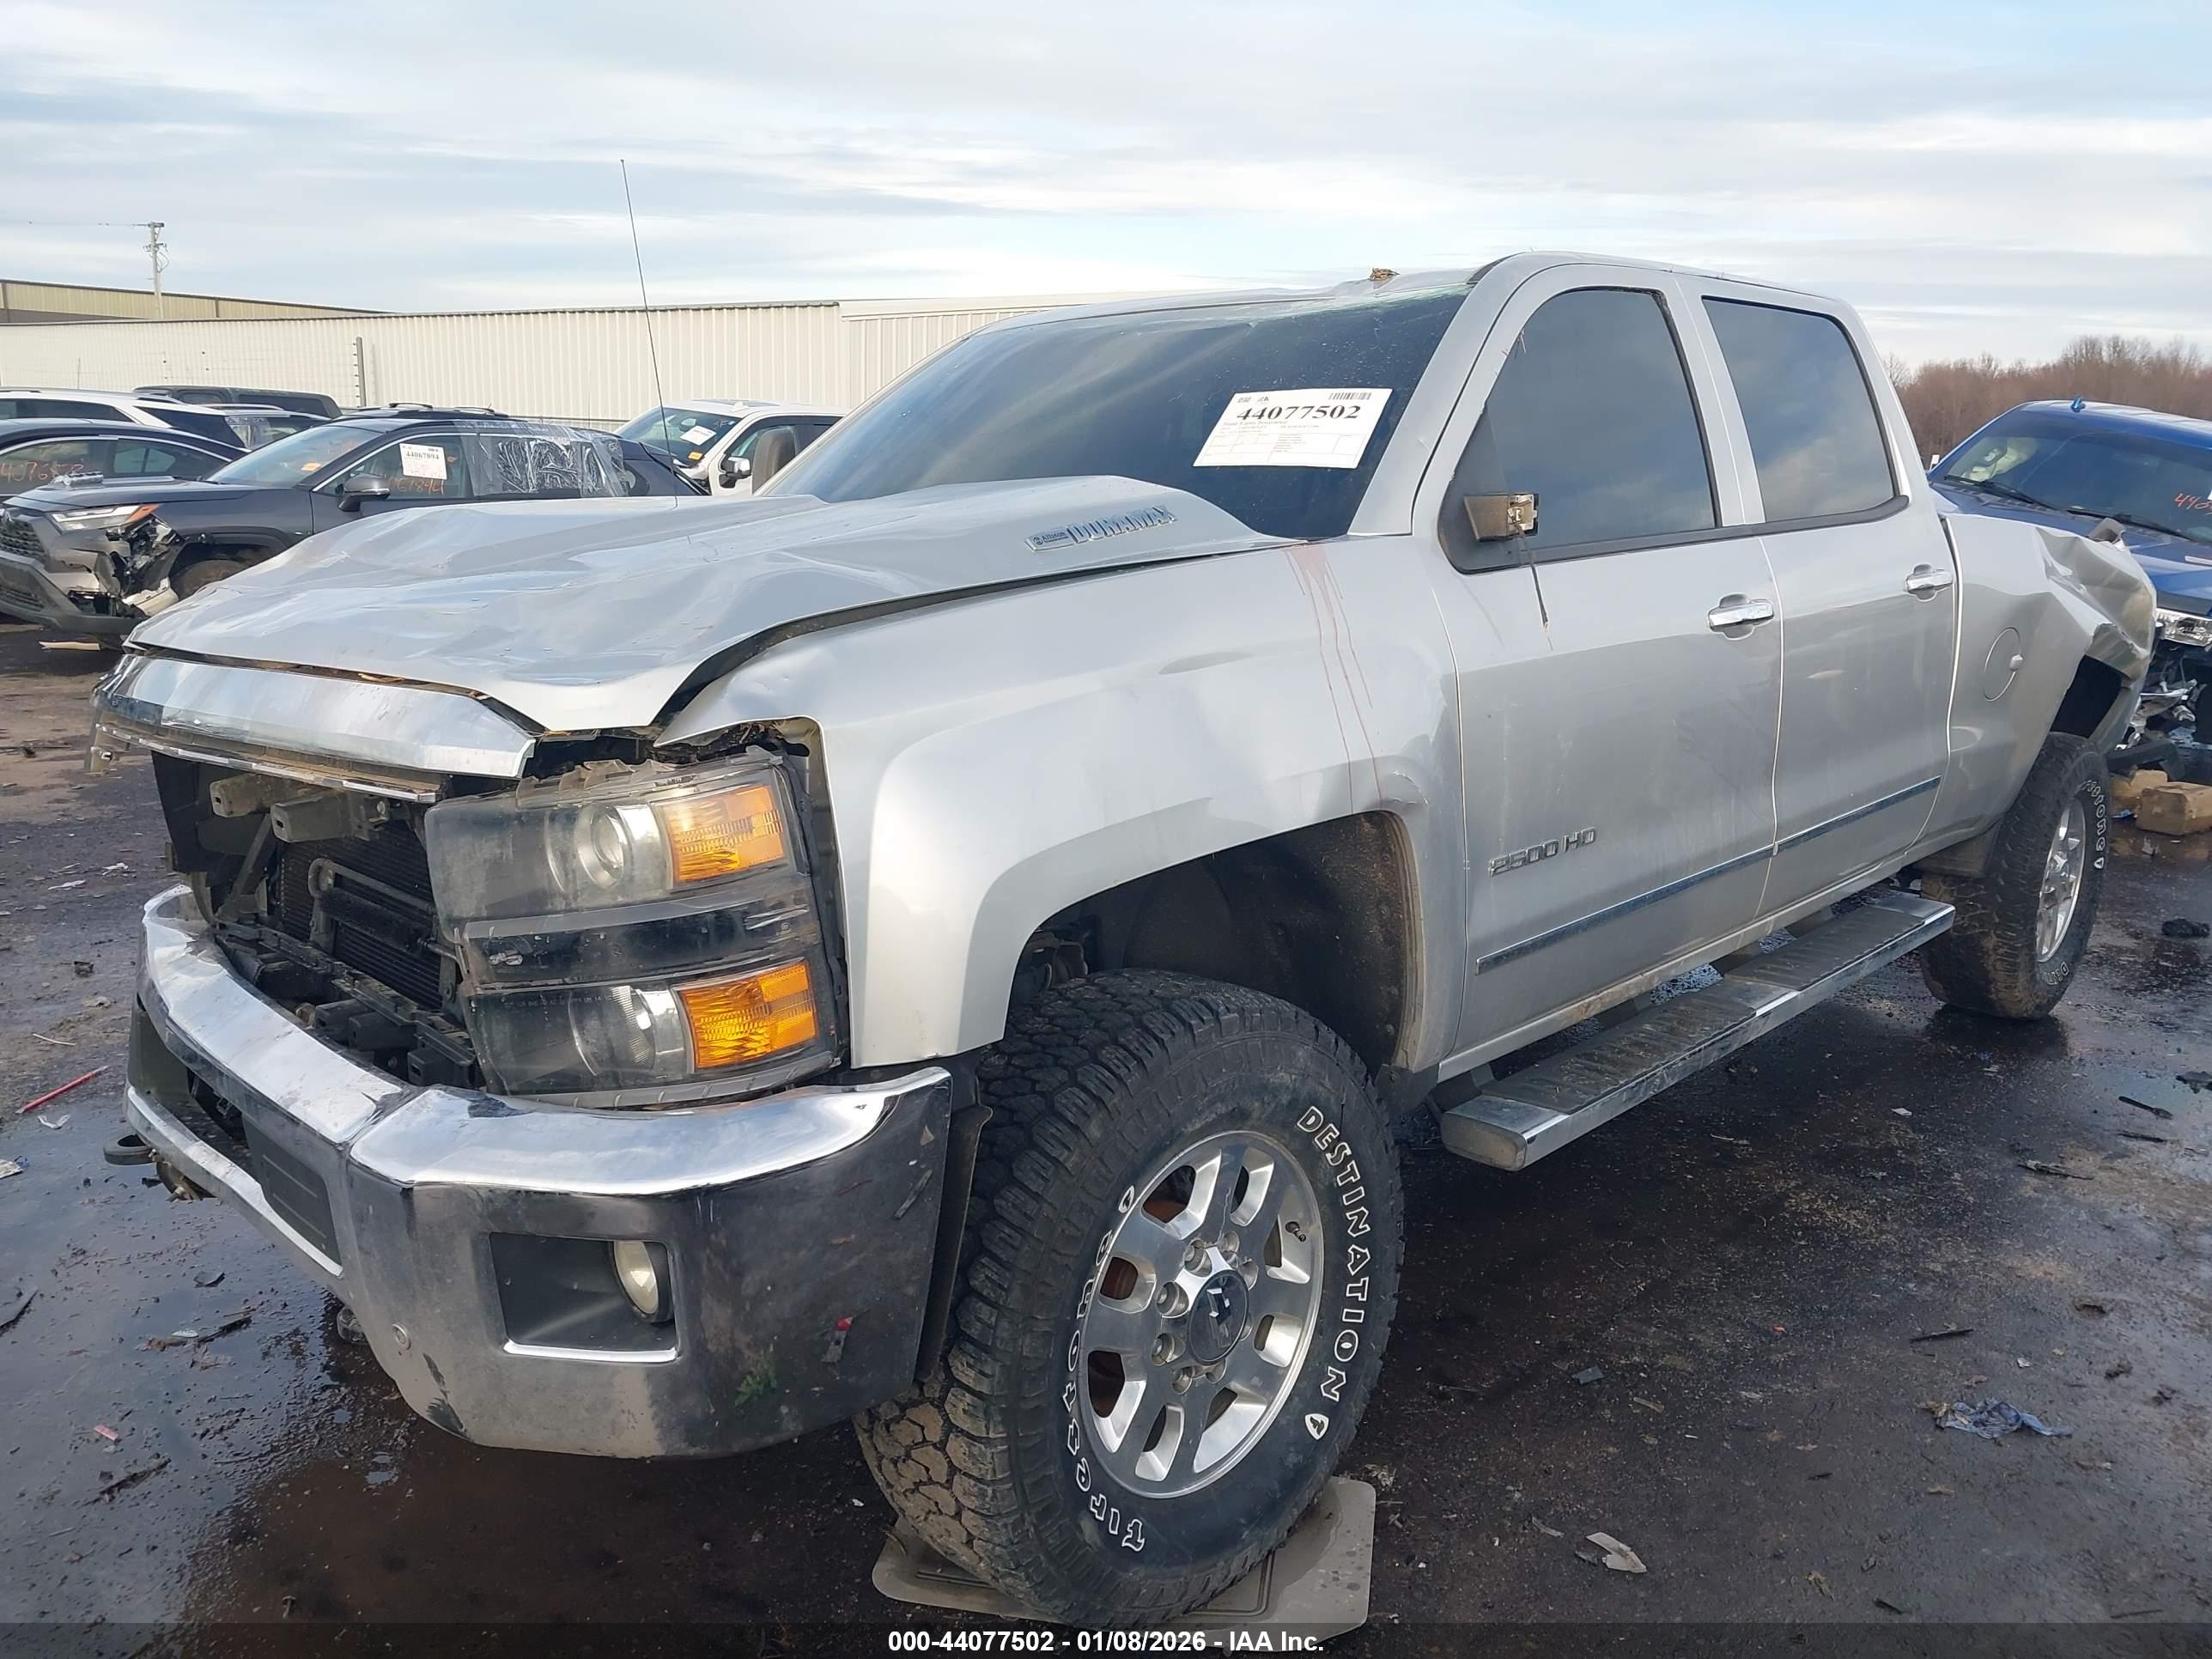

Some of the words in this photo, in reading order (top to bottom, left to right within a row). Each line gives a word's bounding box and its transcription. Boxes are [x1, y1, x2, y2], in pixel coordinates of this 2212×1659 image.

[1237, 405, 1361, 420] 44077502
[1066, 506, 1177, 544] DURAMAX
[1488, 839, 1559, 876] 2500
[1561, 826, 1596, 853] HD
[1297, 1106, 1372, 1402] DESTINATION
